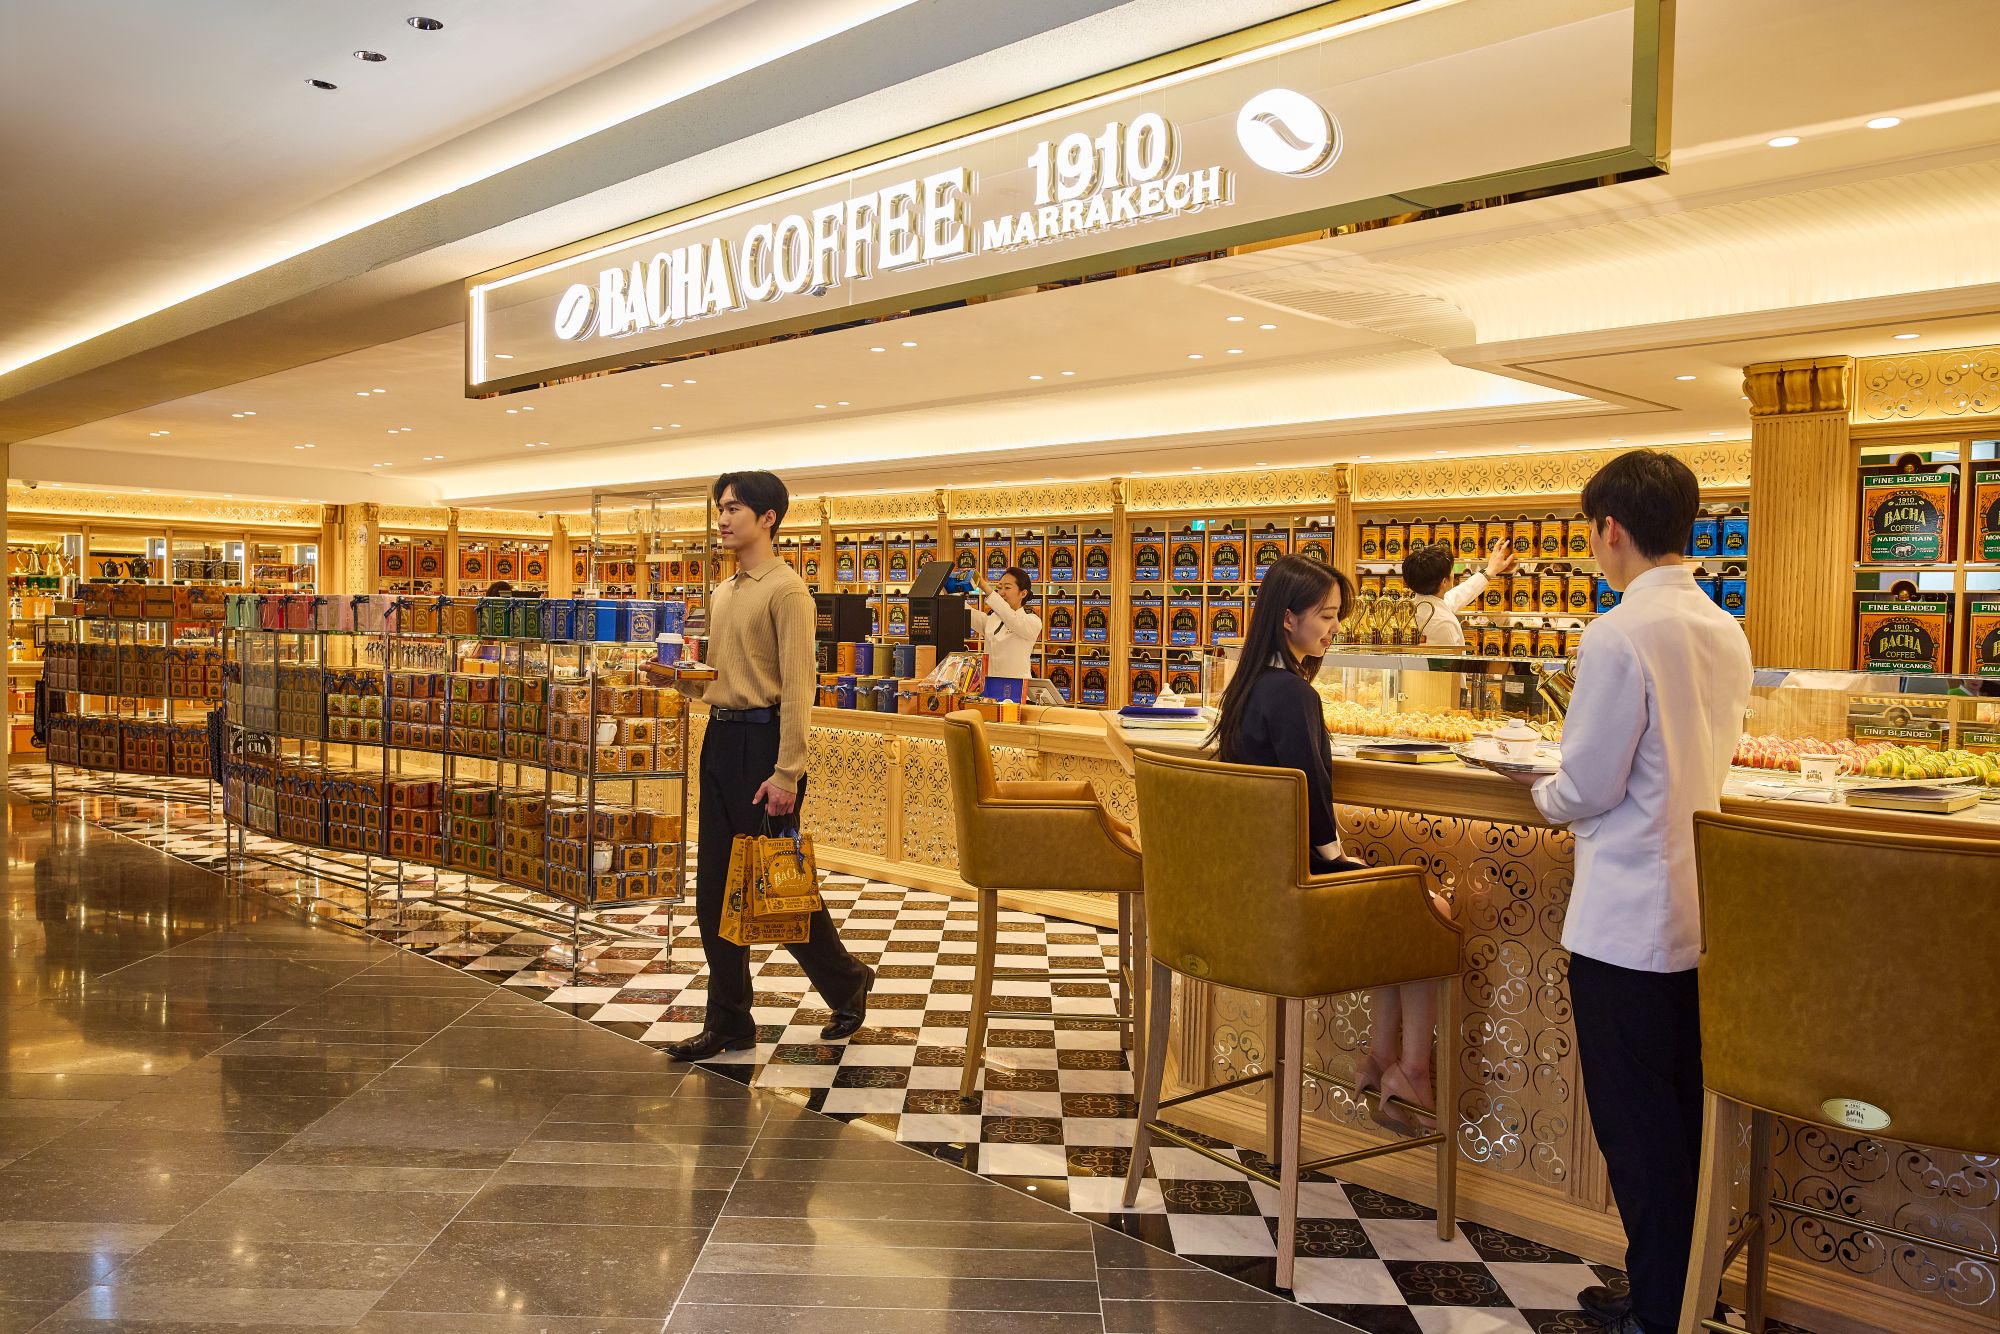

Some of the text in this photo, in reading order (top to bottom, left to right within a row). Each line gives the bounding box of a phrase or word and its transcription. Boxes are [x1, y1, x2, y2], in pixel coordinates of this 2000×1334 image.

[1028, 113, 1176, 206] 1910
[983, 166, 1232, 252] MARRAKECH
[599, 166, 974, 337] BACHA COFFEE
[1896, 475, 1942, 483] BLENDED
[1884, 507, 1927, 528] BACHA
[1890, 524, 1920, 532] COFFEE
[1892, 604, 1936, 612] BLENDED
[1880, 634, 1922, 654] BACHA
[1892, 662, 1933, 670] VOLCANOES
[1864, 728, 1932, 738] FINE BLENDED
